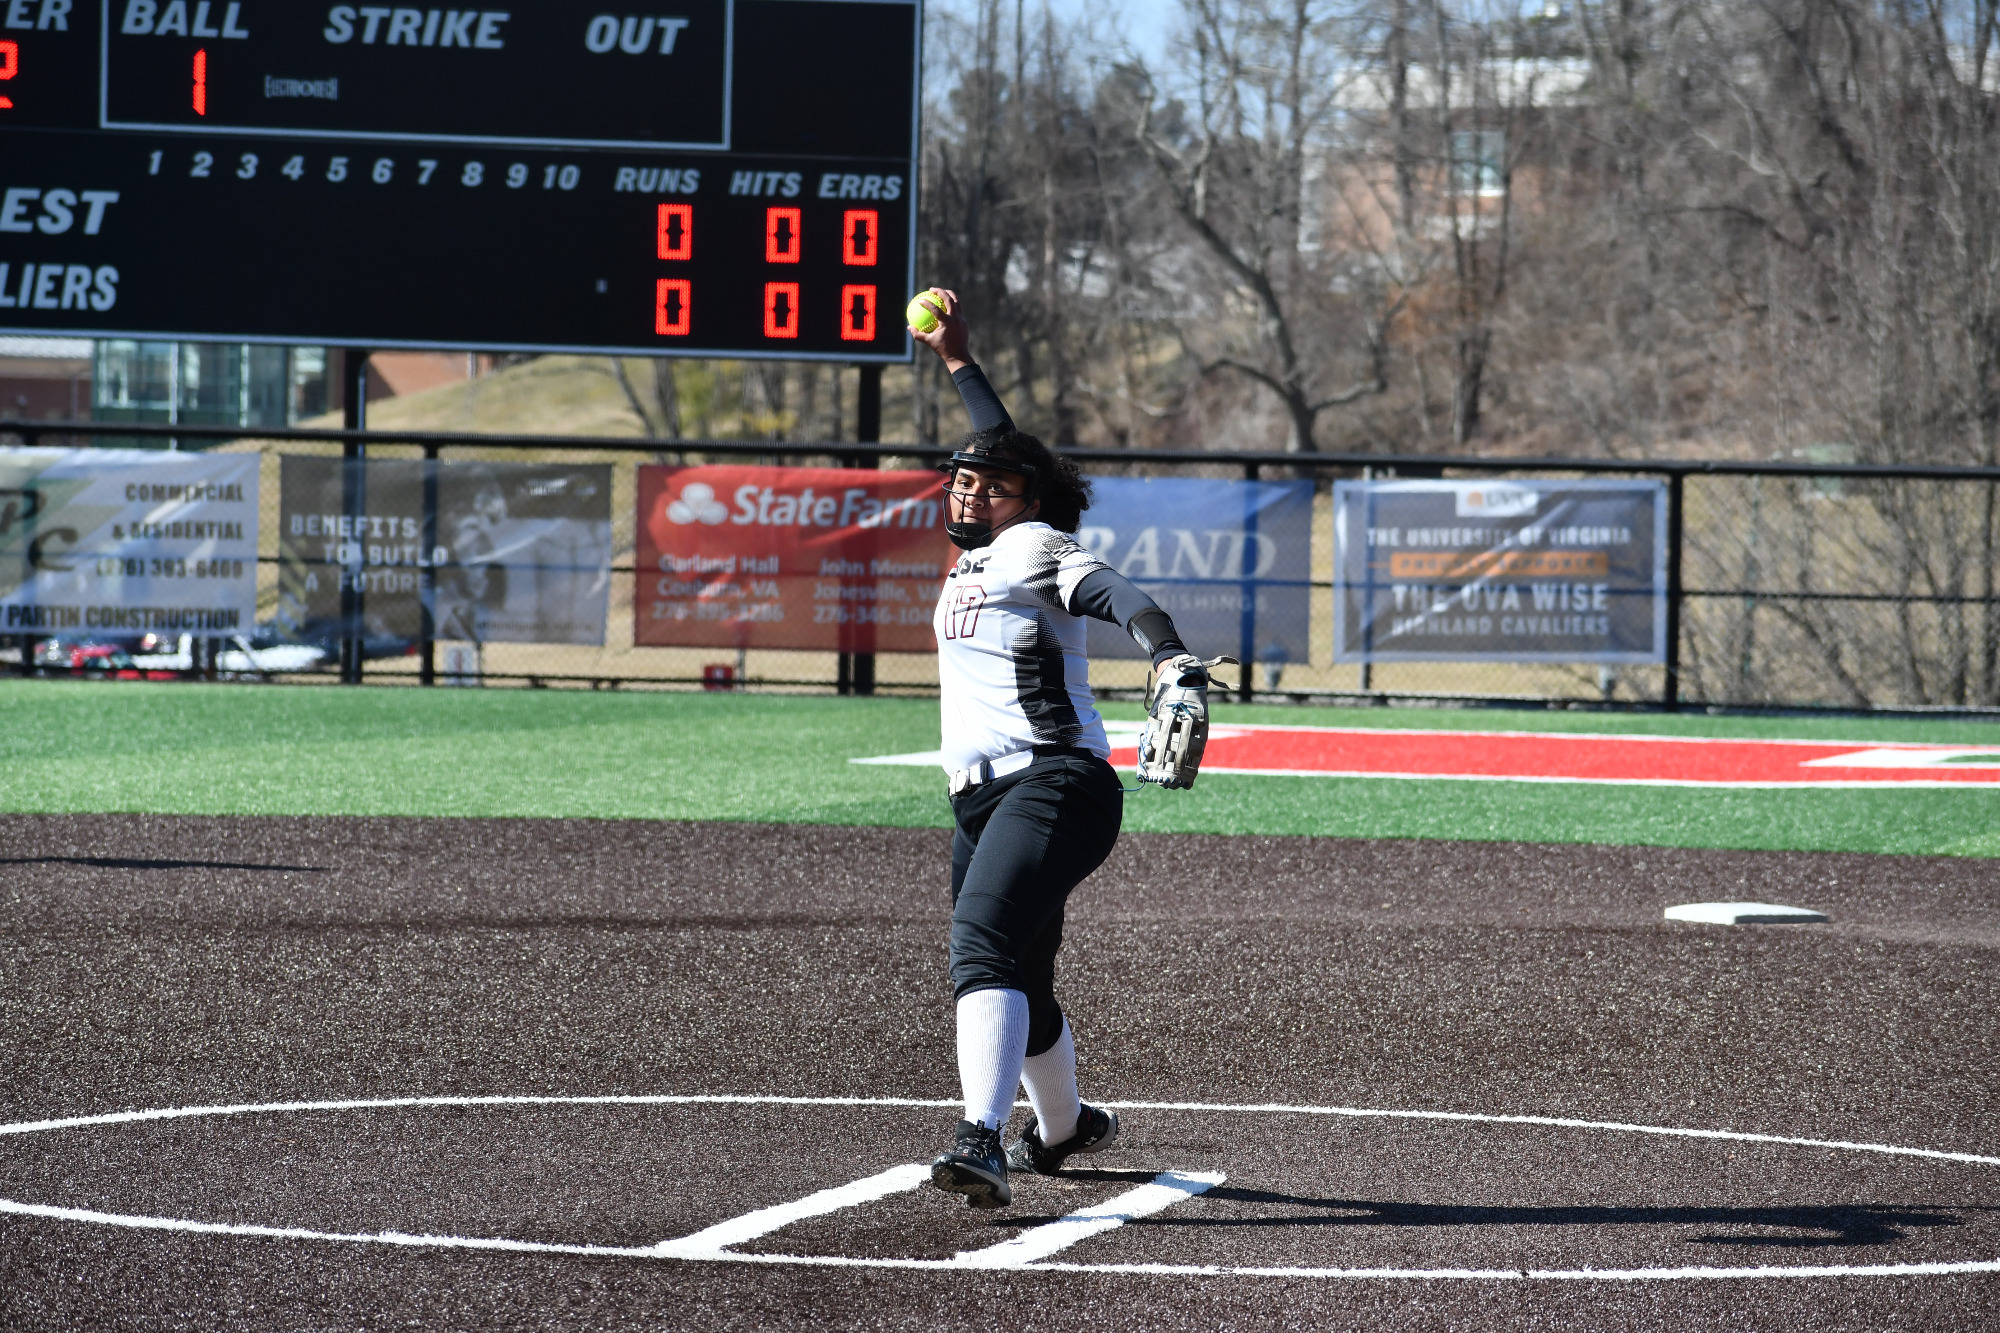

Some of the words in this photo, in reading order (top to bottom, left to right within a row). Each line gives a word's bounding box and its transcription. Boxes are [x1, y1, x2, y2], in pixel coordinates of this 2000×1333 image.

[5, 0, 73, 31] ER
[121, 0, 250, 39] BALL
[323, 6, 511, 49] STRIKE
[584, 14, 690, 55] OUT
[192, 48, 206, 116] 1
[149, 150, 164, 175] 1
[190, 151, 214, 178] 2
[236, 153, 259, 179] 3
[282, 155, 305, 181] 4
[326, 156, 349, 182] 5
[372, 158, 395, 184] 6
[417, 160, 438, 185] 7
[461, 161, 485, 187] 8
[506, 163, 529, 188] 9
[543, 164, 581, 190] 10
[614, 167, 700, 194] RUNS
[729, 170, 802, 197] HITS
[817, 173, 903, 200] ERRS
[0, 188, 120, 235] EST
[657, 204, 692, 260] 0
[766, 208, 801, 263] 0
[843, 210, 878, 266] 0
[0, 263, 120, 311] LIERS
[655, 279, 691, 335] 0
[764, 282, 799, 338] 0
[841, 285, 876, 341] 0
[125, 483, 243, 502] COMMERCIAL
[130, 521, 243, 540] RESIDENTIAL
[290, 514, 418, 538] BENEFITS
[1368, 527, 1399, 546] THE
[1407, 528, 1514, 547] UNIVERSITY
[1519, 526, 1543, 546] OF
[1549, 527, 1632, 546] VIRGINIA
[323, 545, 352, 565] TO
[369, 545, 449, 566] BUILD
[742, 556, 779, 574] Hall
[819, 557, 865, 576] John
[305, 572, 319, 592] A
[750, 580, 780, 598] VA
[1391, 584, 1448, 611] THE
[1460, 582, 1521, 611] UVA
[1531, 583, 1609, 611] WISE
[7, 606, 80, 628] PARTIN
[86, 606, 240, 629] CONSTRUCTION
[813, 604, 933, 627] 276-346-104
[945, 585, 987, 640] 17
[1392, 615, 1493, 636] HIGHLAND
[1500, 617, 1609, 637] CAVALIERS
